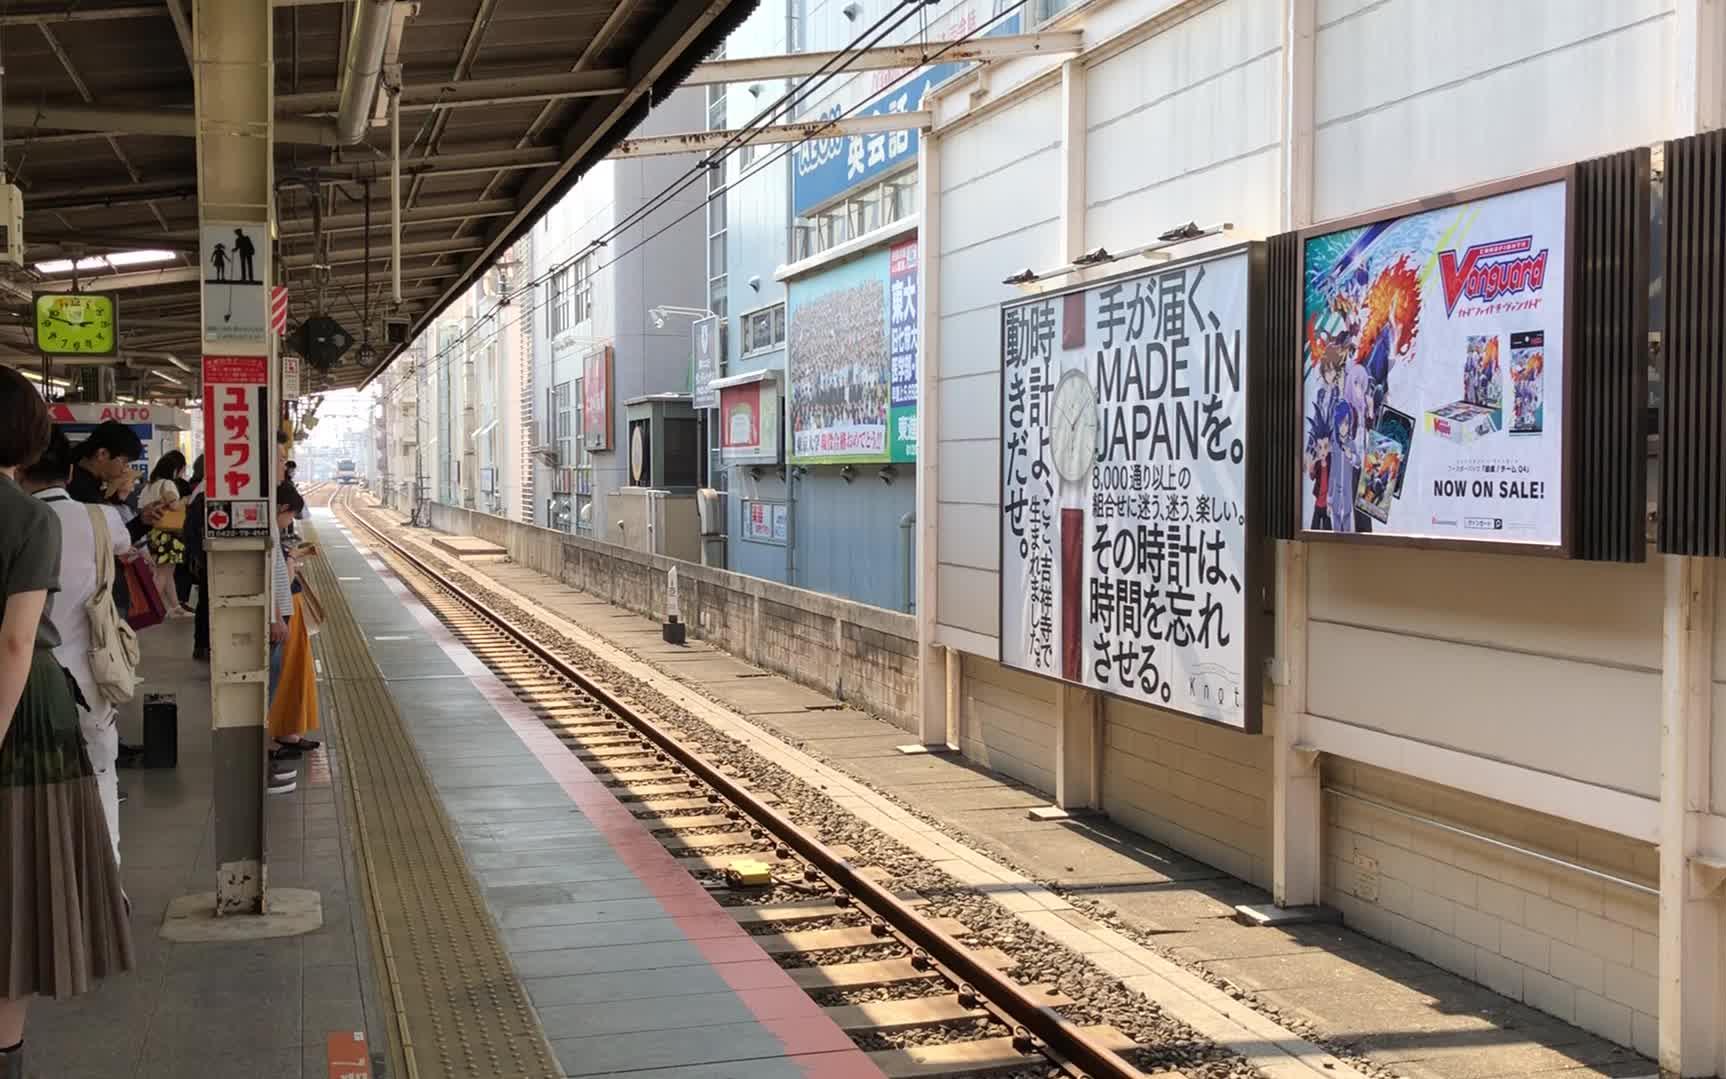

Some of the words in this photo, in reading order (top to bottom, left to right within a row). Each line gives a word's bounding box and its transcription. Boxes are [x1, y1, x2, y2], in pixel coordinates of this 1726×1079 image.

[1096, 266, 1221, 349] 手が届く、
[1438, 248, 1549, 319] Vanguard
[1030, 300, 1055, 497] 時計よ、
[1097, 337, 1190, 404] MADE
[1204, 329, 1241, 394] IN
[100, 406, 150, 421] AUTO
[1005, 307, 1030, 559] 動きだせ。
[1092, 465, 1191, 491] 8,000通り以上の
[1434, 480, 1467, 498] NOW
[1472, 480, 1493, 498] ON
[1499, 481, 1544, 499] SALE!
[1091, 523, 1242, 594] その時計は、
[1089, 577, 1231, 649] 時間を忘れ
[1093, 632, 1172, 703] させる。
